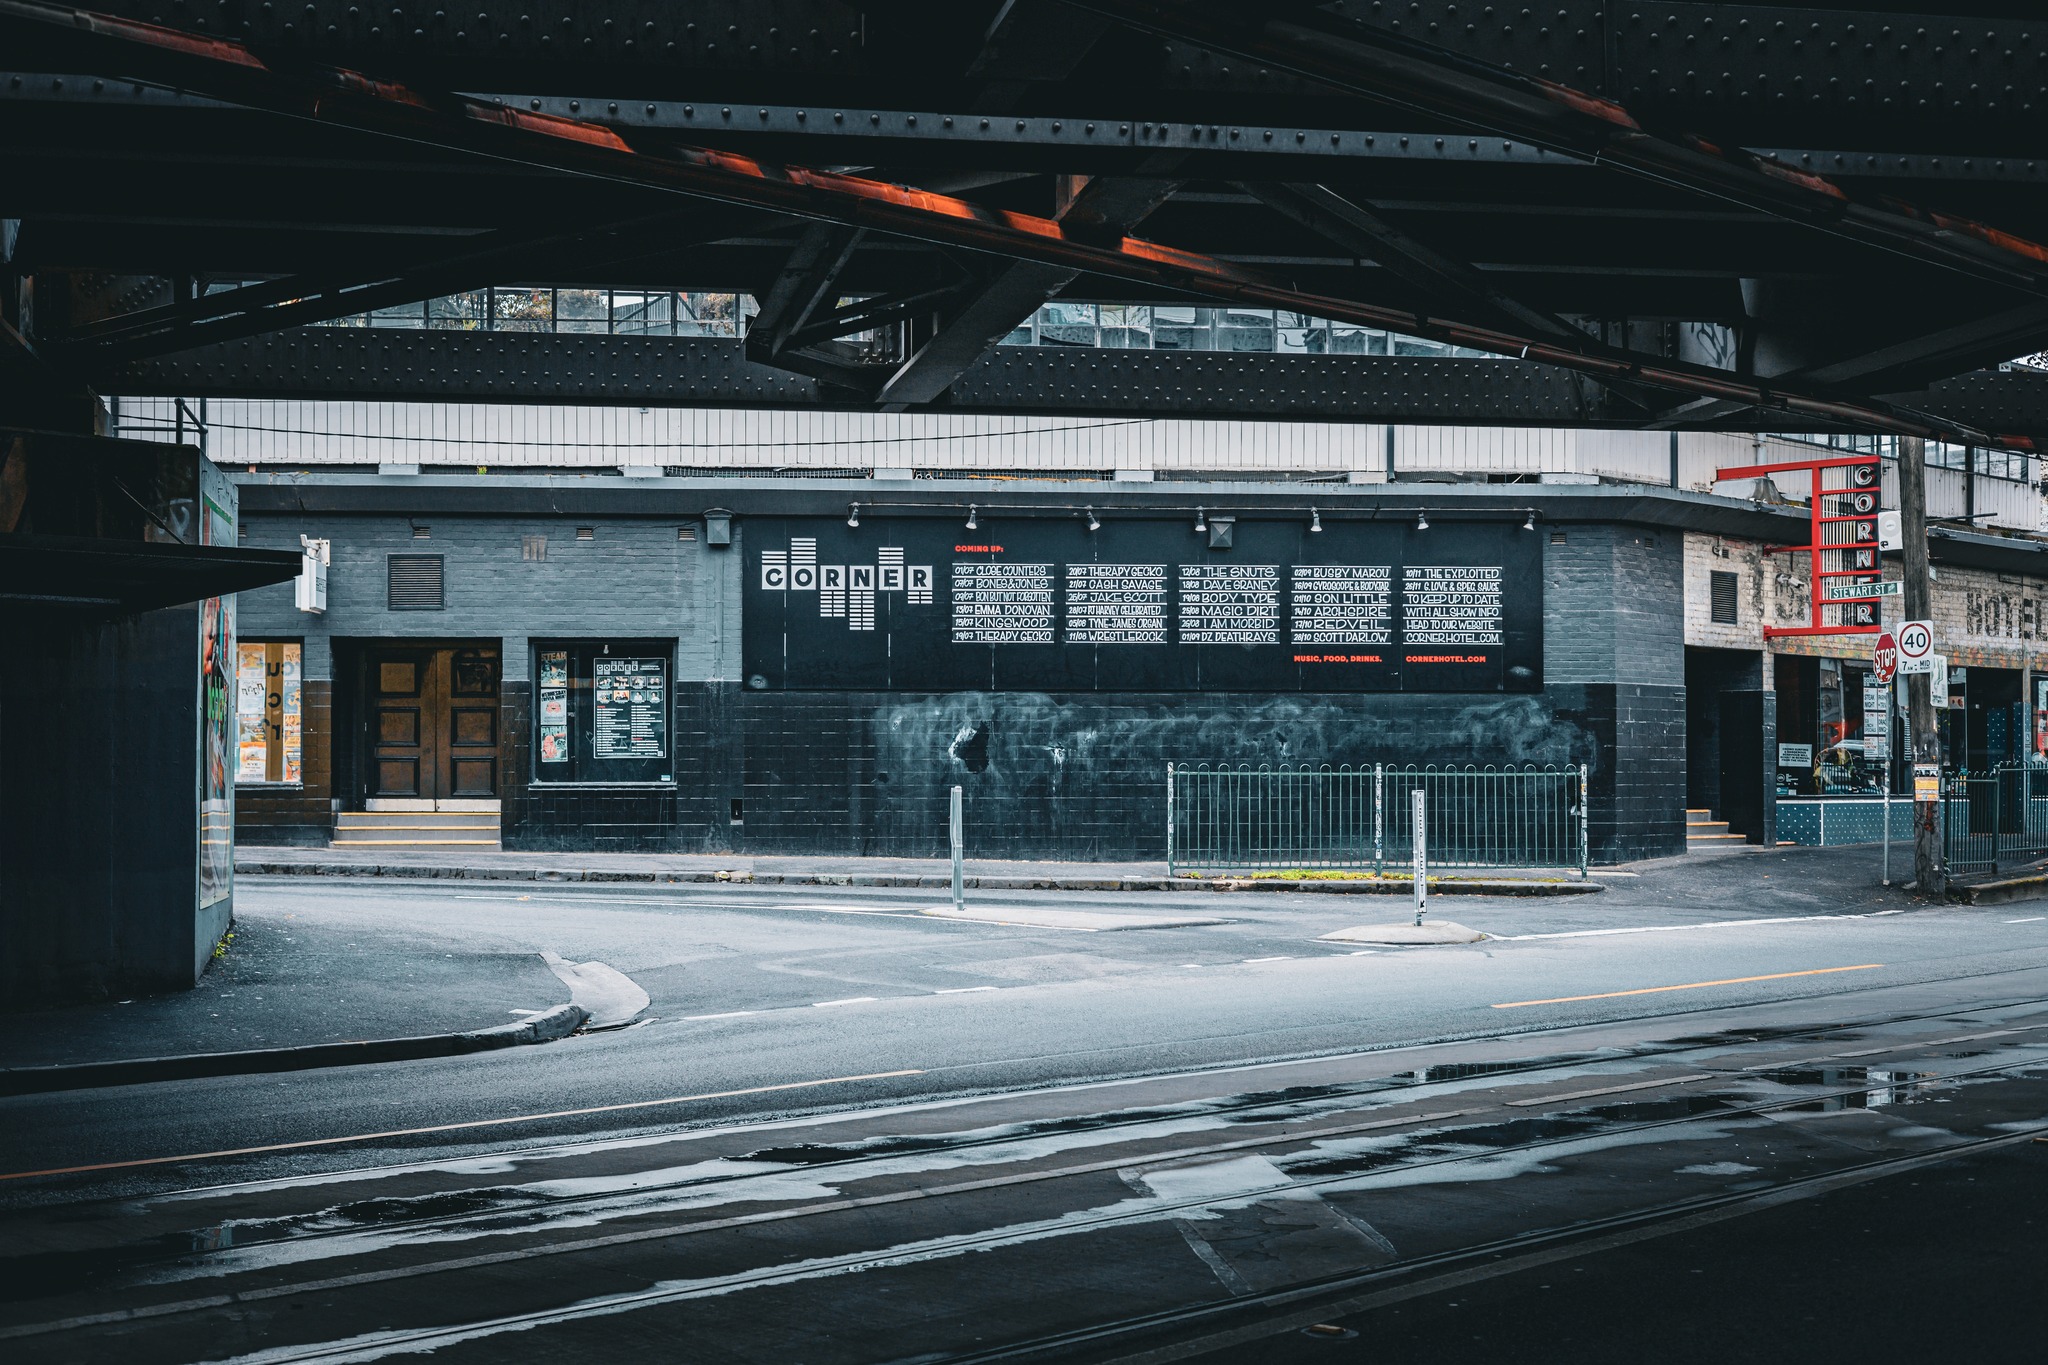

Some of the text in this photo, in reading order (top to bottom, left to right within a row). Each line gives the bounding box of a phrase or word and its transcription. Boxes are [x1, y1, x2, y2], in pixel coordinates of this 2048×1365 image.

[955, 566, 1046, 576] 01/07 CLOSE COUNTERS
[1069, 567, 1162, 576] 20/07 THERAPY GECKO
[1203, 567, 1227, 577] THE
[1230, 568, 1275, 577] SNUTS
[1314, 568, 1350, 577] BUSBY
[1353, 569, 1389, 578] MAROU
[1425, 569, 1442, 578] THE
[1445, 569, 1499, 578] EXPLOITED
[764, 566, 928, 588] CORNER
[955, 579, 974, 588] 07/07
[1069, 580, 1162, 589] 21/07 CASH SAVAGE
[1203, 580, 1231, 590] DAVE
[1233, 580, 1277, 590] GRANEY
[1313, 582, 1353, 590] GYROSCOPE
[1354, 582, 1360, 590] &
[1360, 582, 1389, 591] BODYJAR
[1449, 583, 1455, 591] &
[1478, 583, 1499, 591] SAUCE
[1834, 585, 1885, 598] STEWART ST
[976, 592, 989, 601] BON
[990, 592, 1002, 602] BUT
[1004, 592, 1016, 602] NOT
[1017, 592, 1050, 602] FORGOTTEN
[1090, 593, 1122, 602] JAKE
[1123, 593, 1163, 602] SCOTT
[1202, 593, 1238, 602] BODY
[1242, 594, 1276, 603] TYPE
[1314, 594, 1339, 603] SON
[1343, 594, 1387, 604] LITTLE
[1407, 595, 1499, 604] TO KEEP UP TO DATE
[975, 605, 1001, 614] EMMA
[1005, 605, 1050, 615] DONOVAN
[1096, 606, 1119, 615] HARVEY
[1121, 606, 1161, 615] CELEBRATED
[1202, 606, 1243, 615] MAGIC
[1247, 606, 1277, 616] DIRT
[1314, 607, 1387, 616] ARCHSPIRE
[1406, 608, 1499, 617] WITH ALL SHOW INFO
[955, 618, 1048, 628] 15/07 KINGSWOOD
[1089, 618, 1136, 628] TYNE-JAMES
[1138, 619, 1162, 628] ORGAN
[1211, 619, 1227, 628] AM
[1231, 619, 1274, 628] MORBID
[1314, 620, 1384, 629] REDVEIL
[1407, 620, 1494, 629] HEAD TO OUR WEBSITE
[955, 632, 1051, 641] 19/07 THERAPY GECKO
[1089, 631, 1163, 641] WRESTLEROCK
[1182, 632, 1275, 641] 01/09 DZ DEATHRAYS
[1313, 633, 1345, 642] SCOTT
[1346, 633, 1387, 642] DARLOW
[1904, 632, 1926, 648] 40
[541, 652, 566, 661] STEAK
[1876, 648, 1896, 669] STOP
